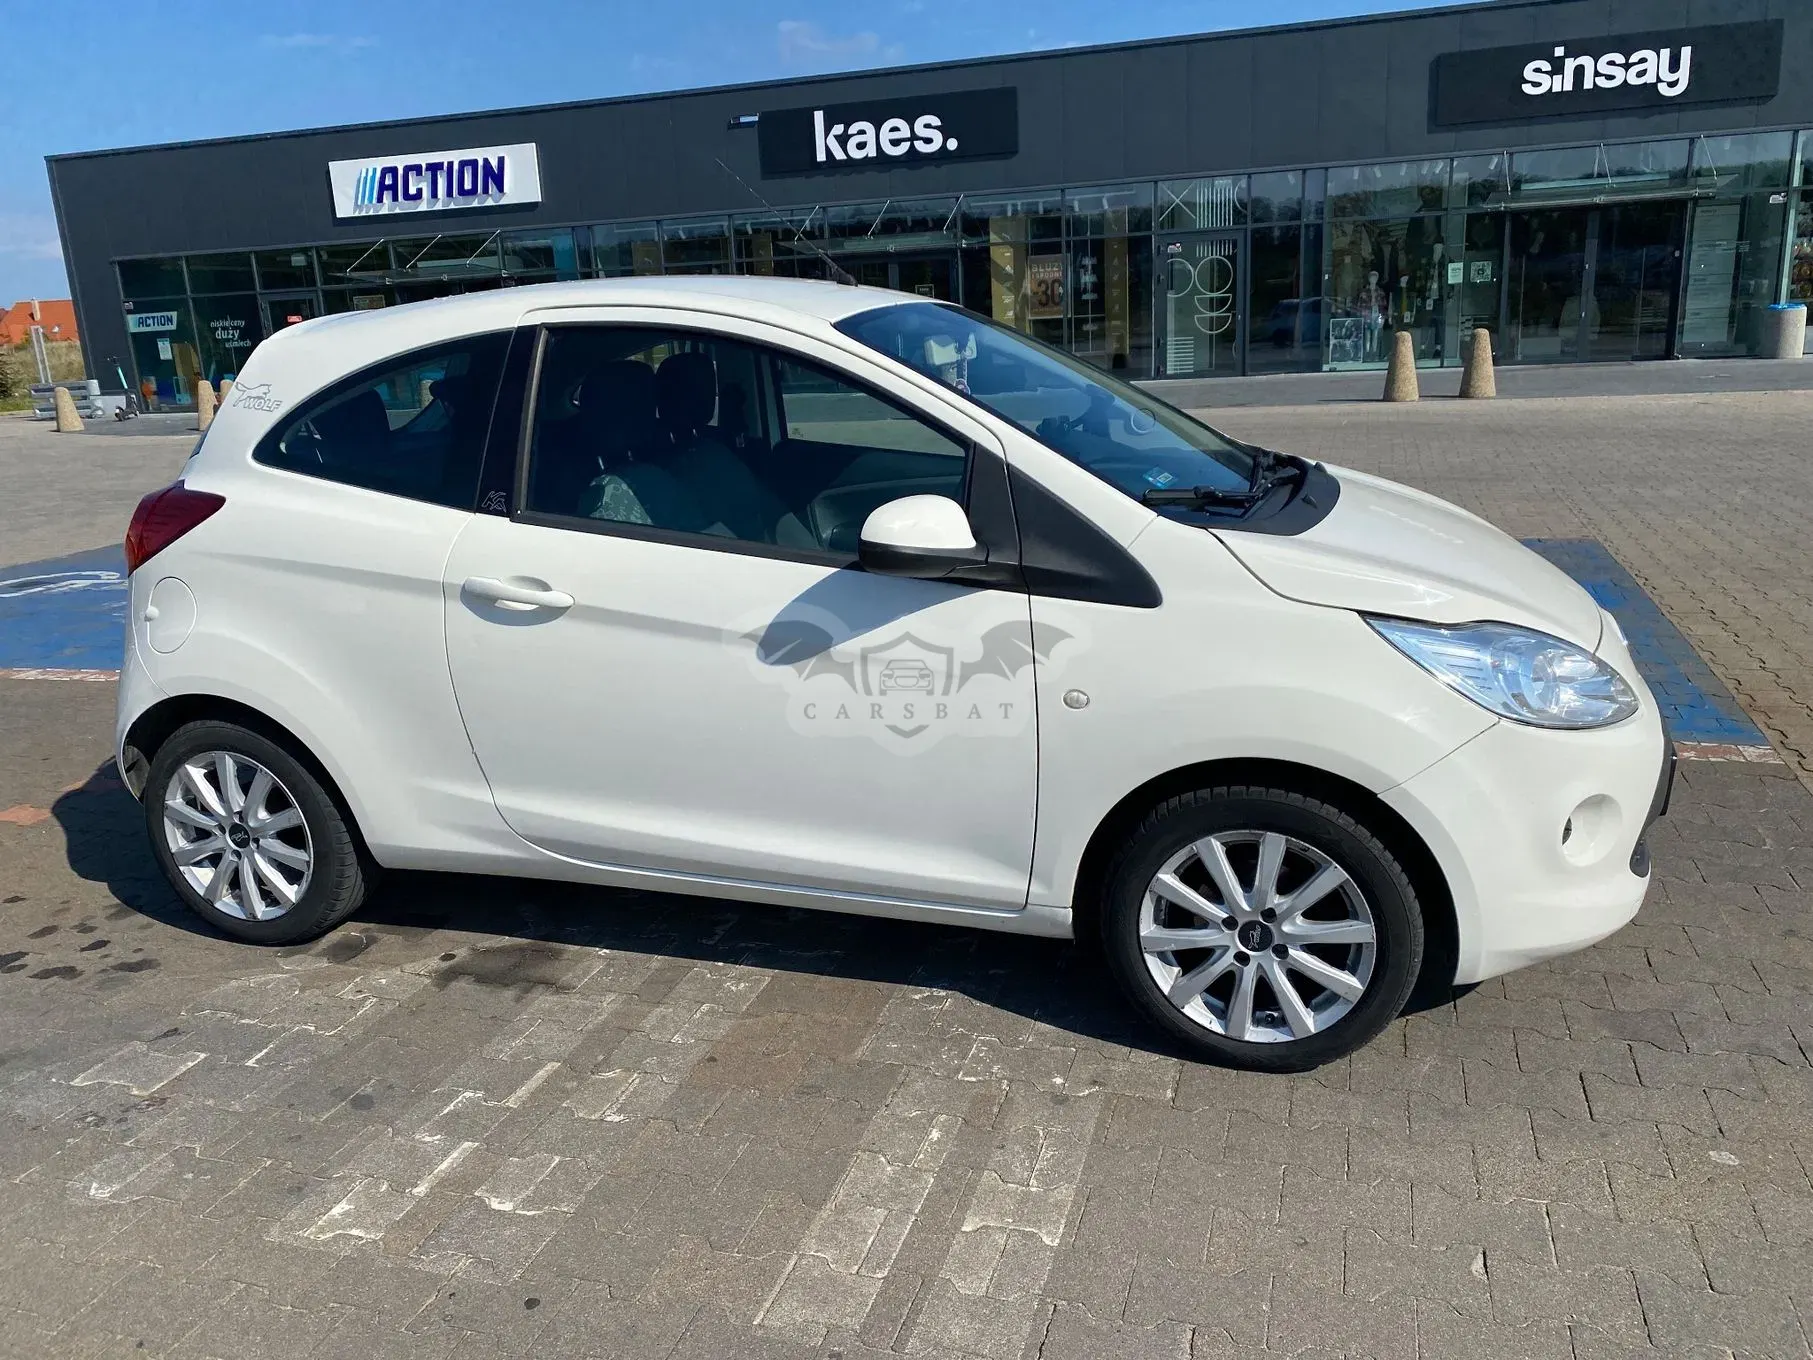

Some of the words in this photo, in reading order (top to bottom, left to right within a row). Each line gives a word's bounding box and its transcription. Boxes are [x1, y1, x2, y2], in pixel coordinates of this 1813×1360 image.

[1521, 45, 1692, 97] sinsay
[813, 110, 959, 163] kaes.
[376, 155, 506, 204] ACTION
[137, 314, 174, 328] ACTION
[230, 319, 245, 328] ceny
[215, 327, 240, 340] duży
[243, 397, 283, 412] WOLF
